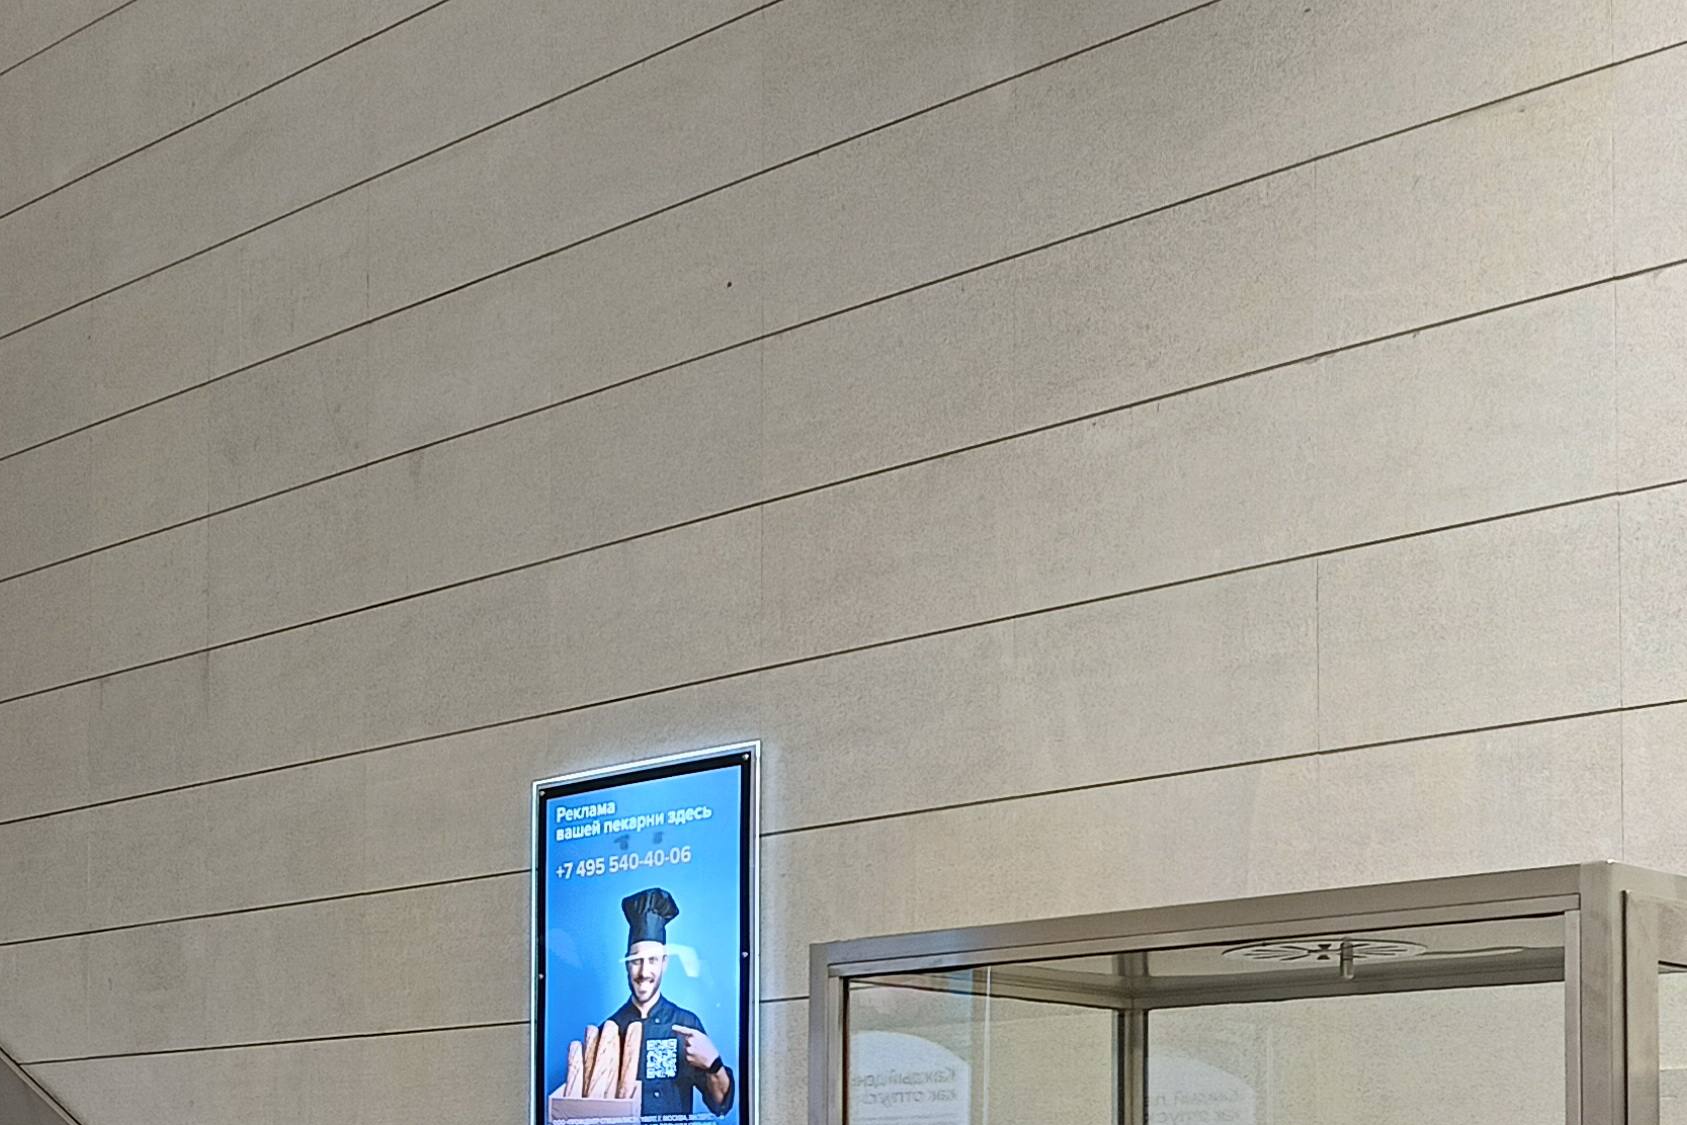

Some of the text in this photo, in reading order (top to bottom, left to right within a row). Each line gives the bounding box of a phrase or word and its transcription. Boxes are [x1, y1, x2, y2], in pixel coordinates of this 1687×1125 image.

[556, 801, 616, 823] Реклама
[556, 805, 712, 841] вашей пекарни здесь
[555, 846, 692, 879] +7 495 540-40-06
